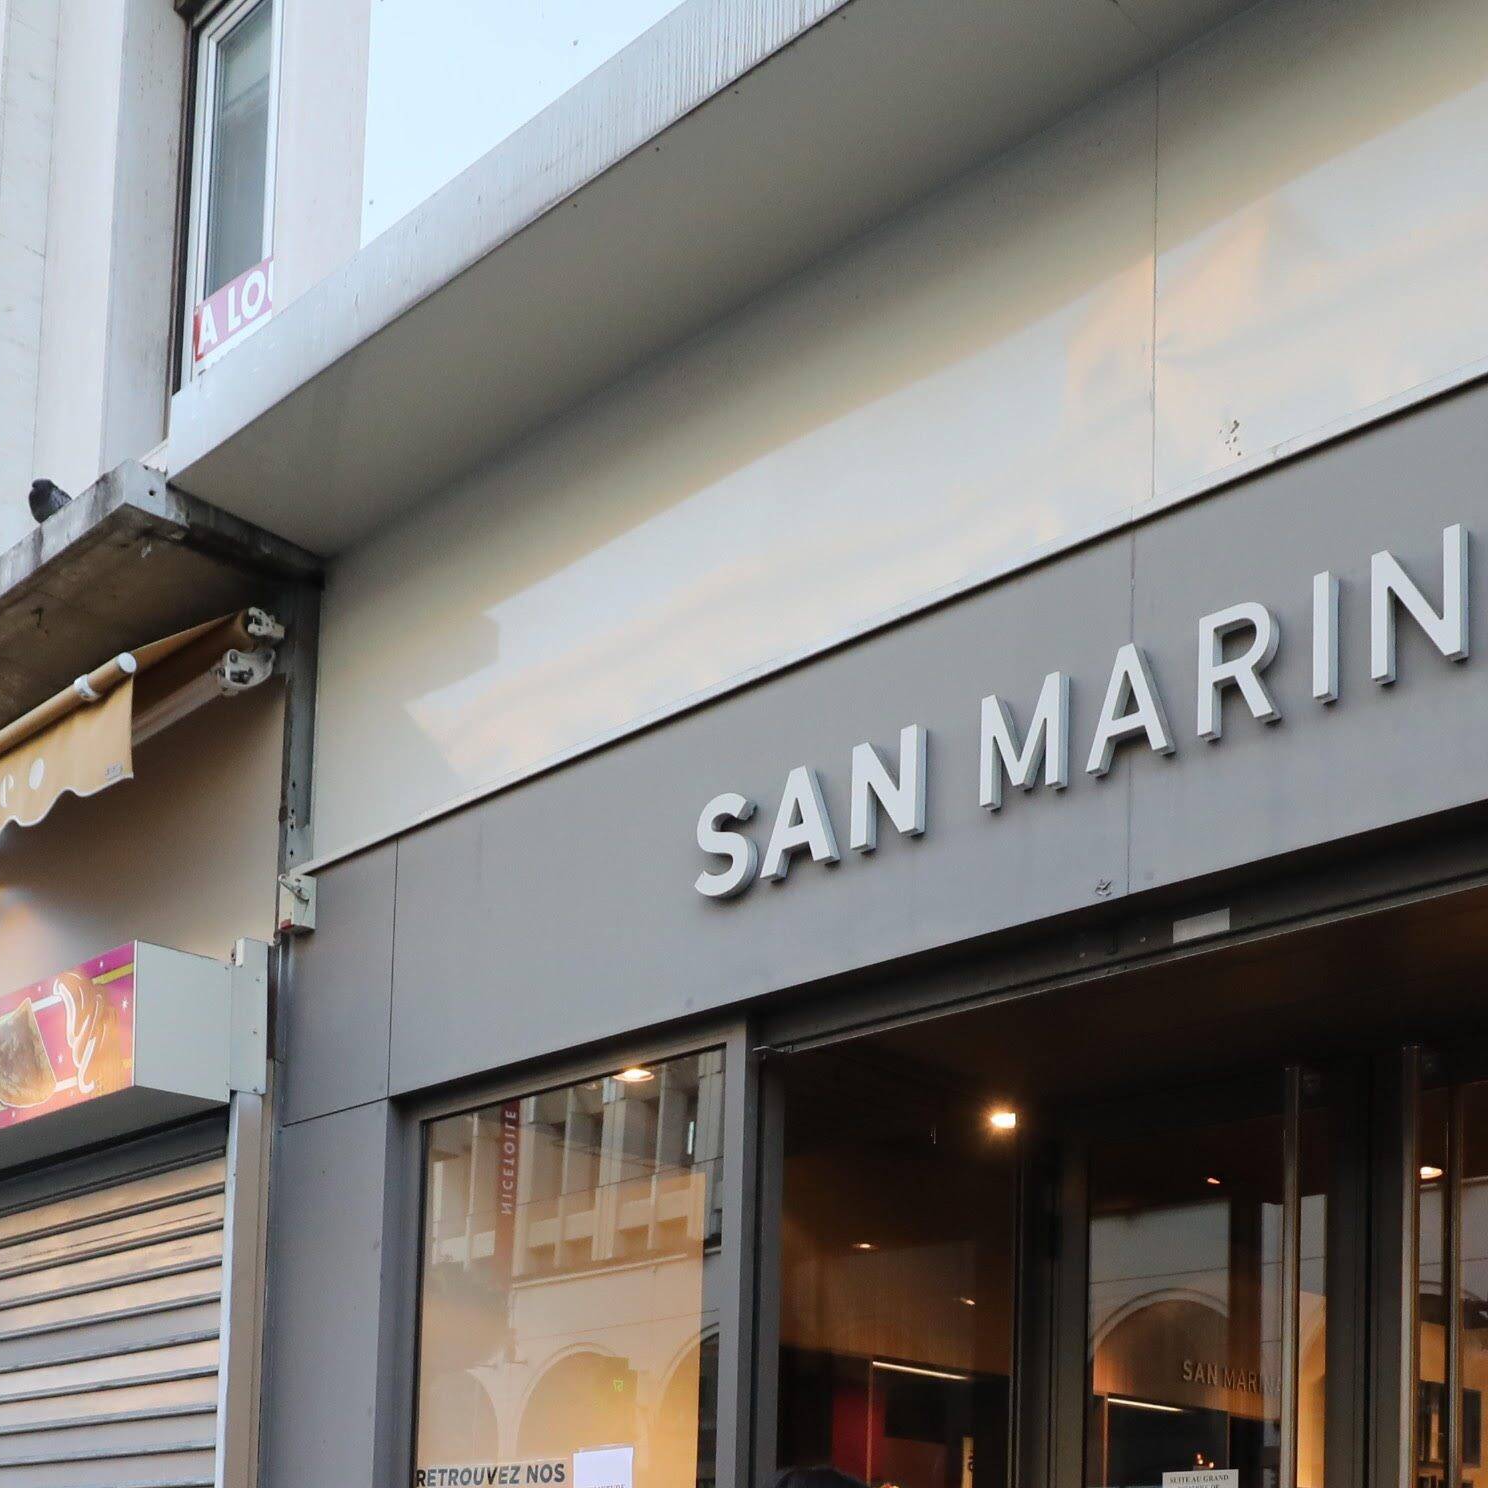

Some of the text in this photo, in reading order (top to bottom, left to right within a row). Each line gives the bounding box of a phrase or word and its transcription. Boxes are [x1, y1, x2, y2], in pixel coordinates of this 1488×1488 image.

[694, 724, 928, 900] SAN
[1183, 1360, 1218, 1387] SAN
[416, 1463, 565, 1487] RETROUVEZ NOS
